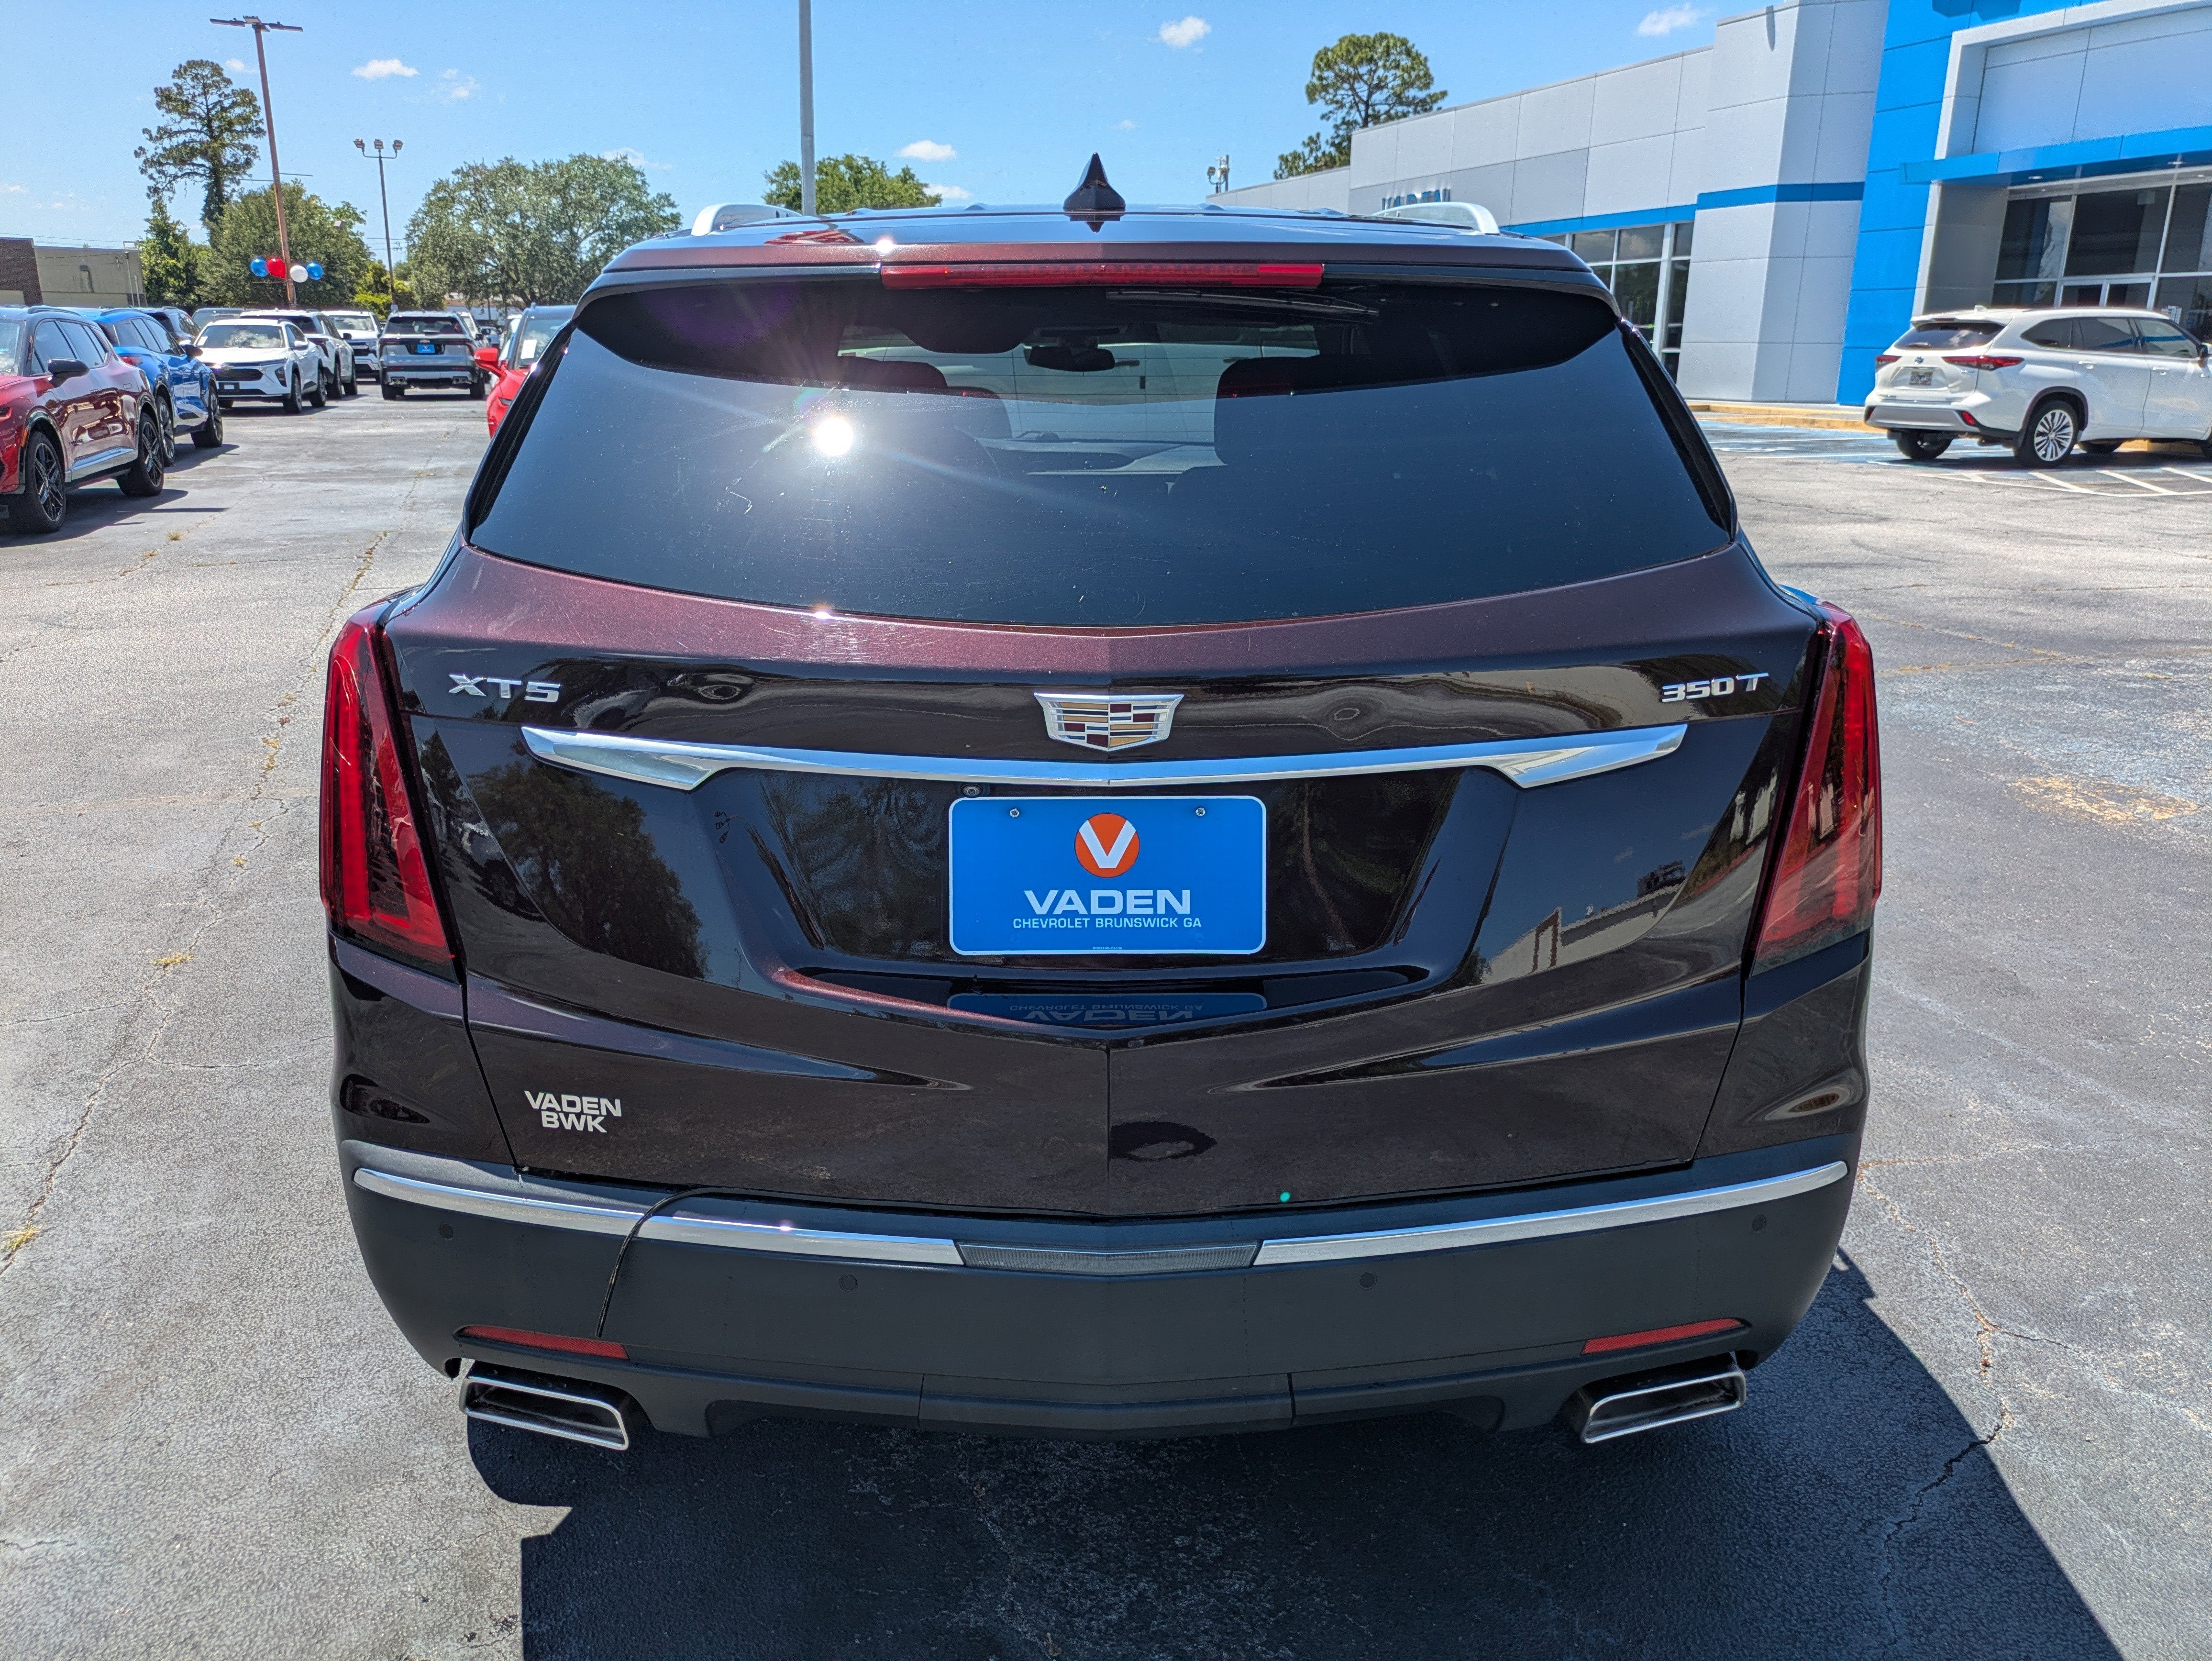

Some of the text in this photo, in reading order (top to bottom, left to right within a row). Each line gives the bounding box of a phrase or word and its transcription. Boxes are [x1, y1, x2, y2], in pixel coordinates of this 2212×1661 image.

[448, 674, 561, 703] XT5
[1661, 672, 1769, 703] 350T
[1024, 889, 1191, 915] VADEN
[1013, 917, 1202, 929] CHEVROLET BRUNSWICK GA
[524, 1090, 622, 1117] VADEN
[541, 1111, 608, 1133] BWK
